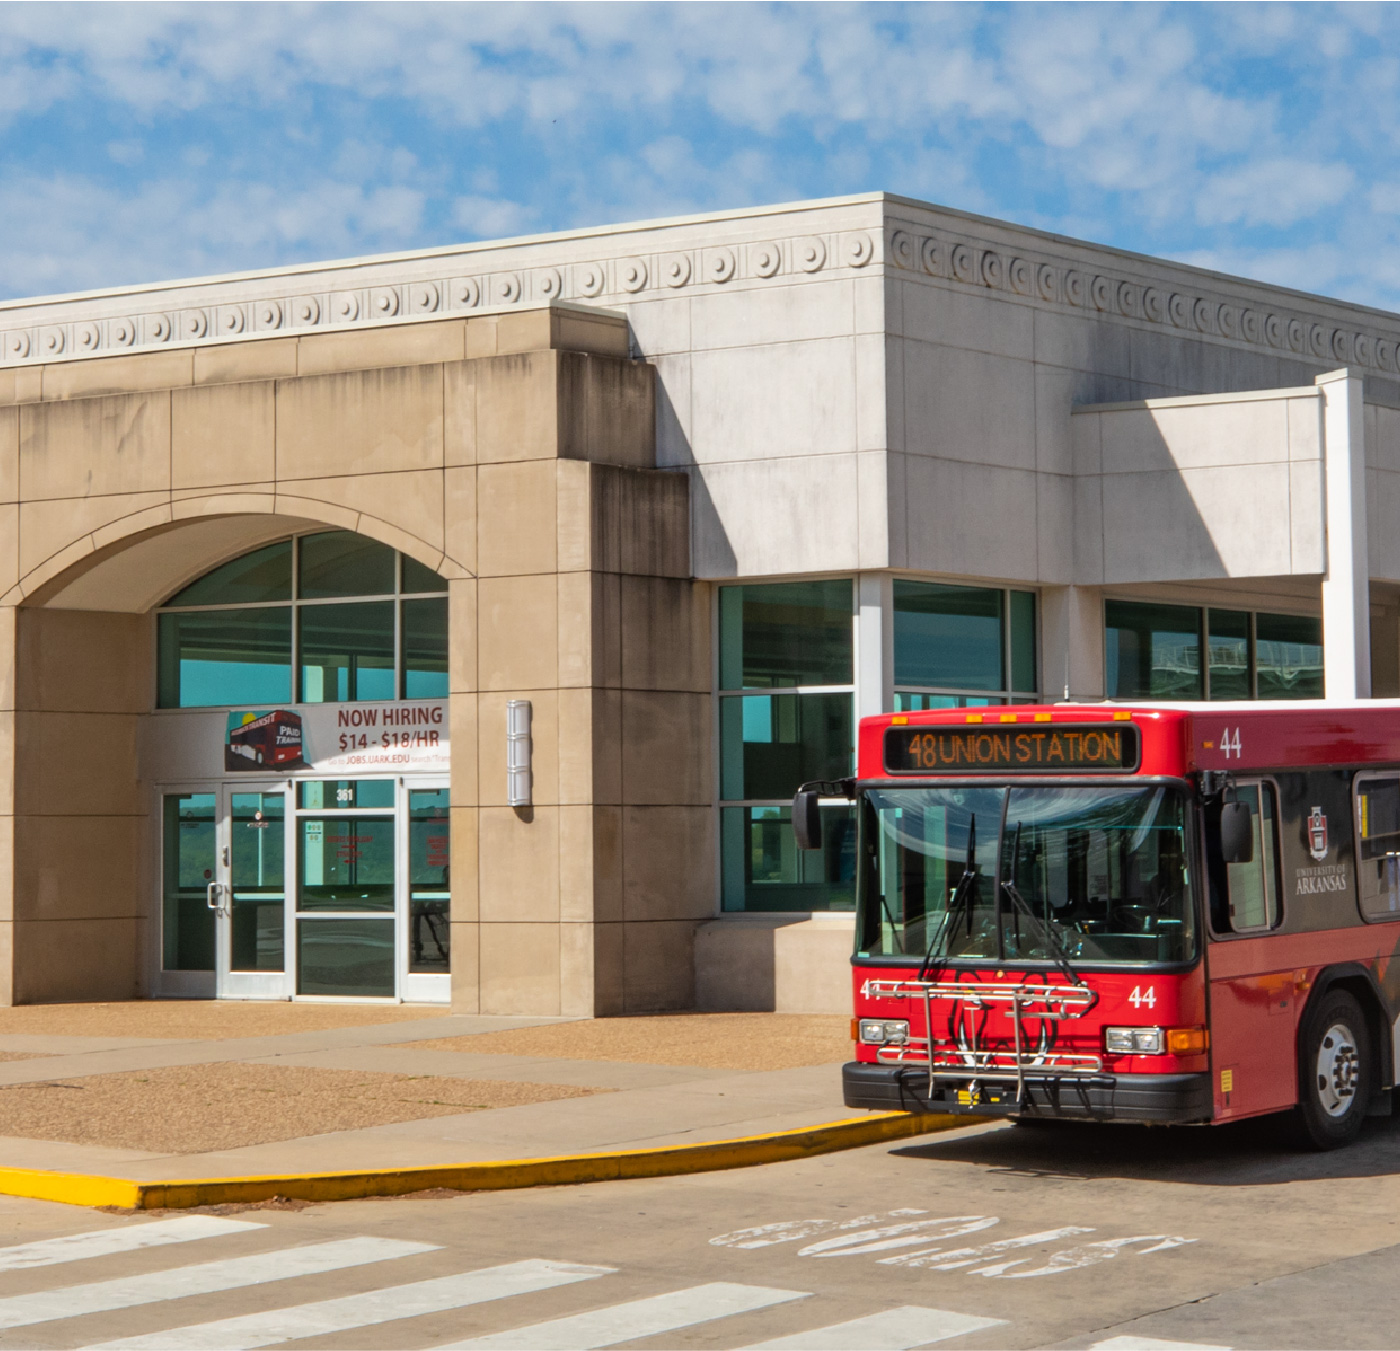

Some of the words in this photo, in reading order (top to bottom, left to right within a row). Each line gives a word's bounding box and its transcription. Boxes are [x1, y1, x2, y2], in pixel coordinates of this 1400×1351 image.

[338, 709, 377, 727] NOW
[383, 707, 442, 725] HIRING
[339, 733, 367, 752] $14
[382, 730, 439, 751] $18/HR
[908, 735, 937, 767] 48
[939, 733, 1011, 763] UNION
[1015, 731, 1121, 763] STATION
[1219, 727, 1242, 759] 44
[346, 754, 410, 765] JOBS.UARK.EDU
[336, 789, 353, 801] 361
[1296, 865, 1336, 878] UNIVERSITY
[1337, 863, 1345, 874] OF
[1295, 874, 1346, 895] ARKANSAS
[1128, 985, 1157, 1009] 44
